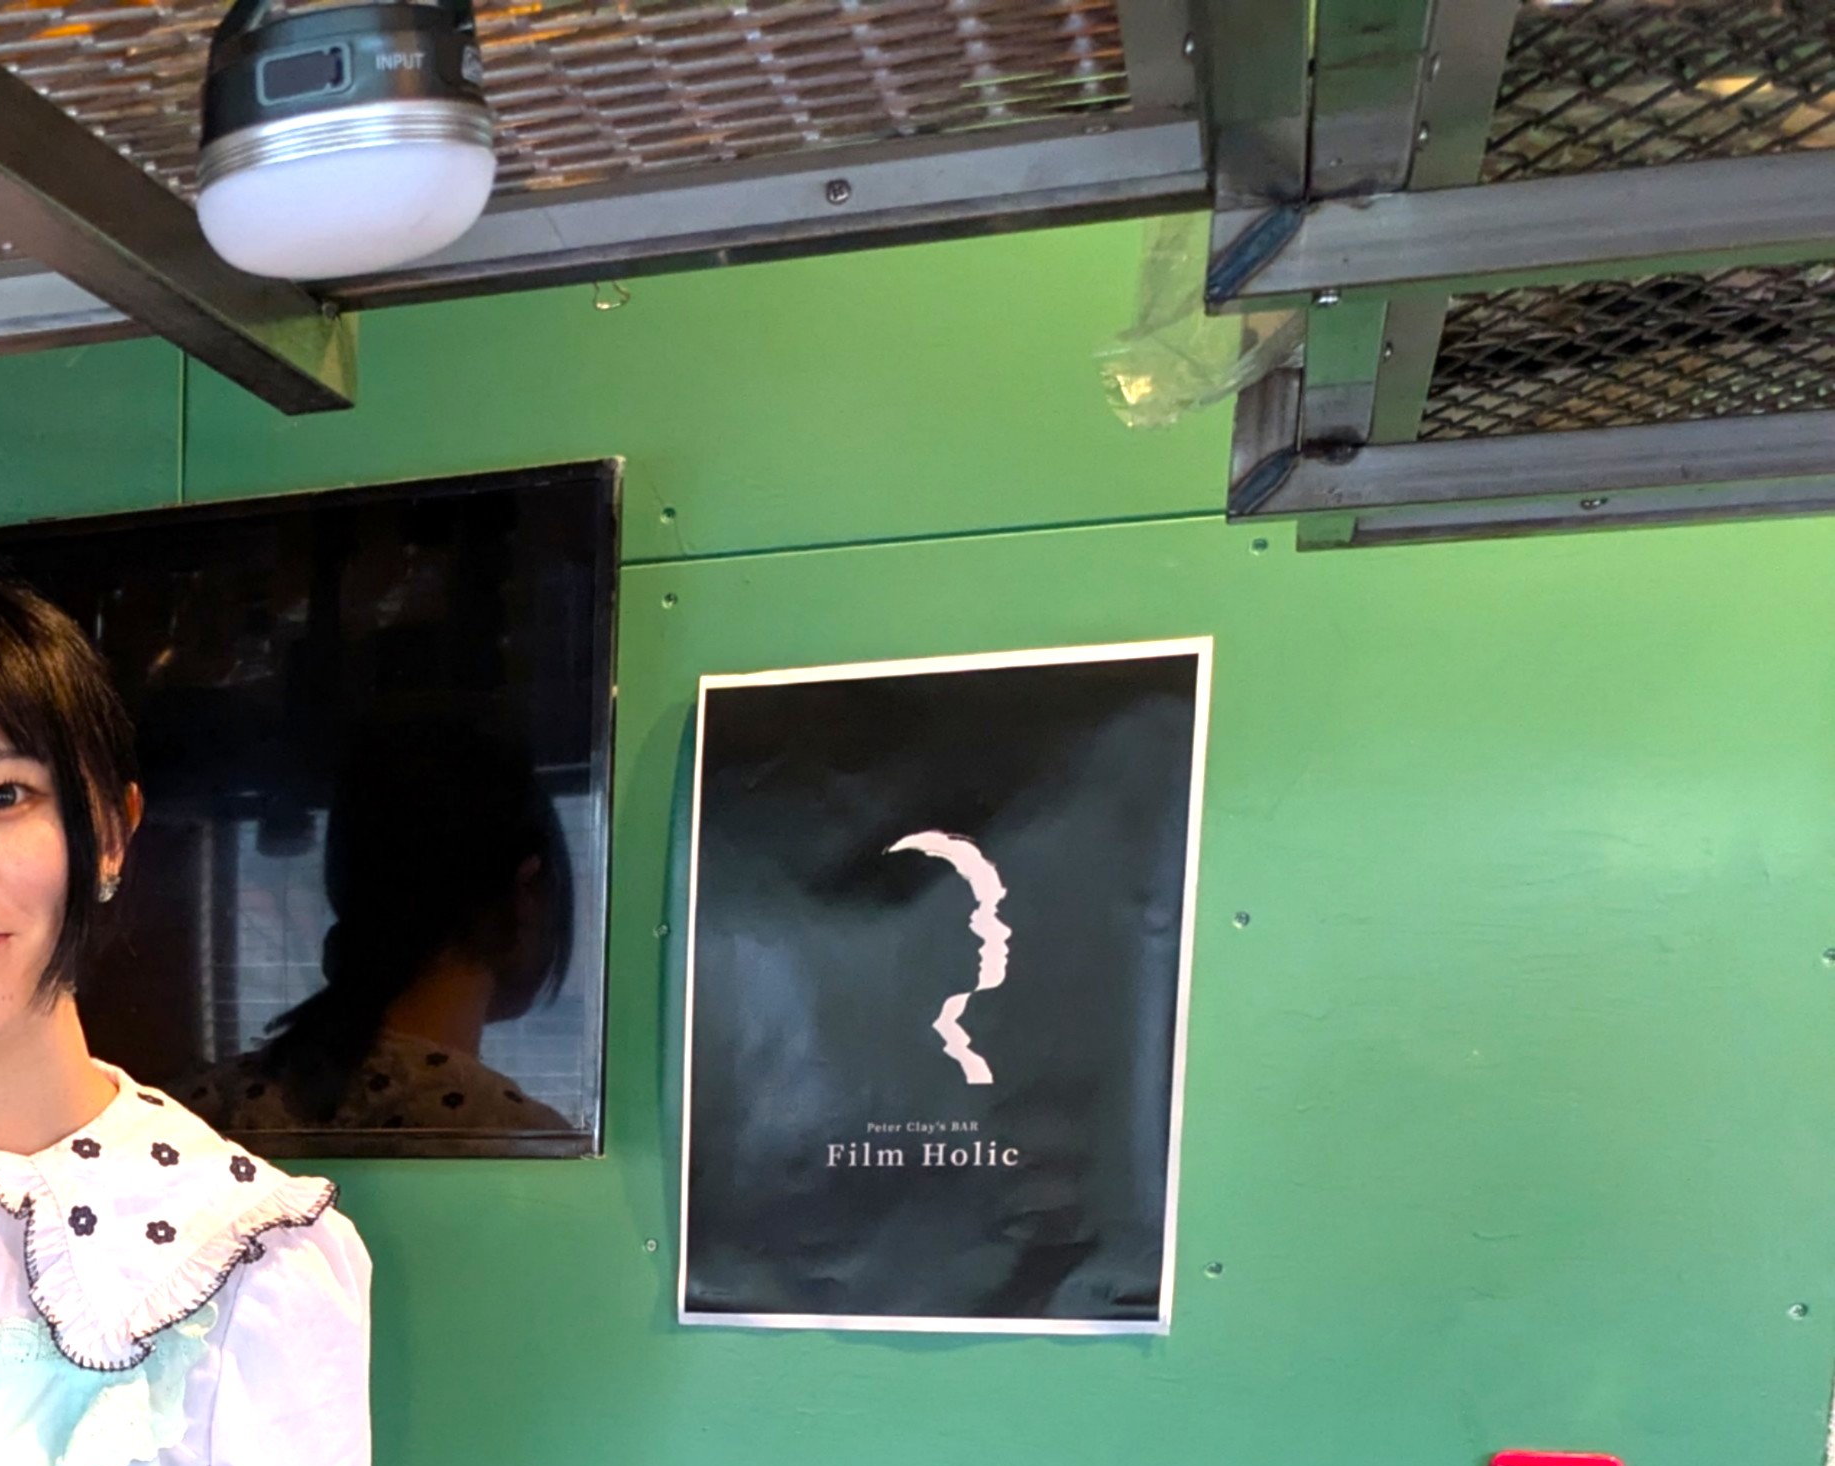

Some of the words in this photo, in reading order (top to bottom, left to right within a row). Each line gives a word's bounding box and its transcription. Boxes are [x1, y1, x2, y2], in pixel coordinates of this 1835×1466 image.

[375, 52, 426, 70] INPUT
[867, 1122, 901, 1133] Peter
[906, 1121, 946, 1134] Clay's
[951, 1121, 979, 1132] BAR
[826, 1142, 905, 1167] Film
[921, 1140, 1019, 1167] Holic
